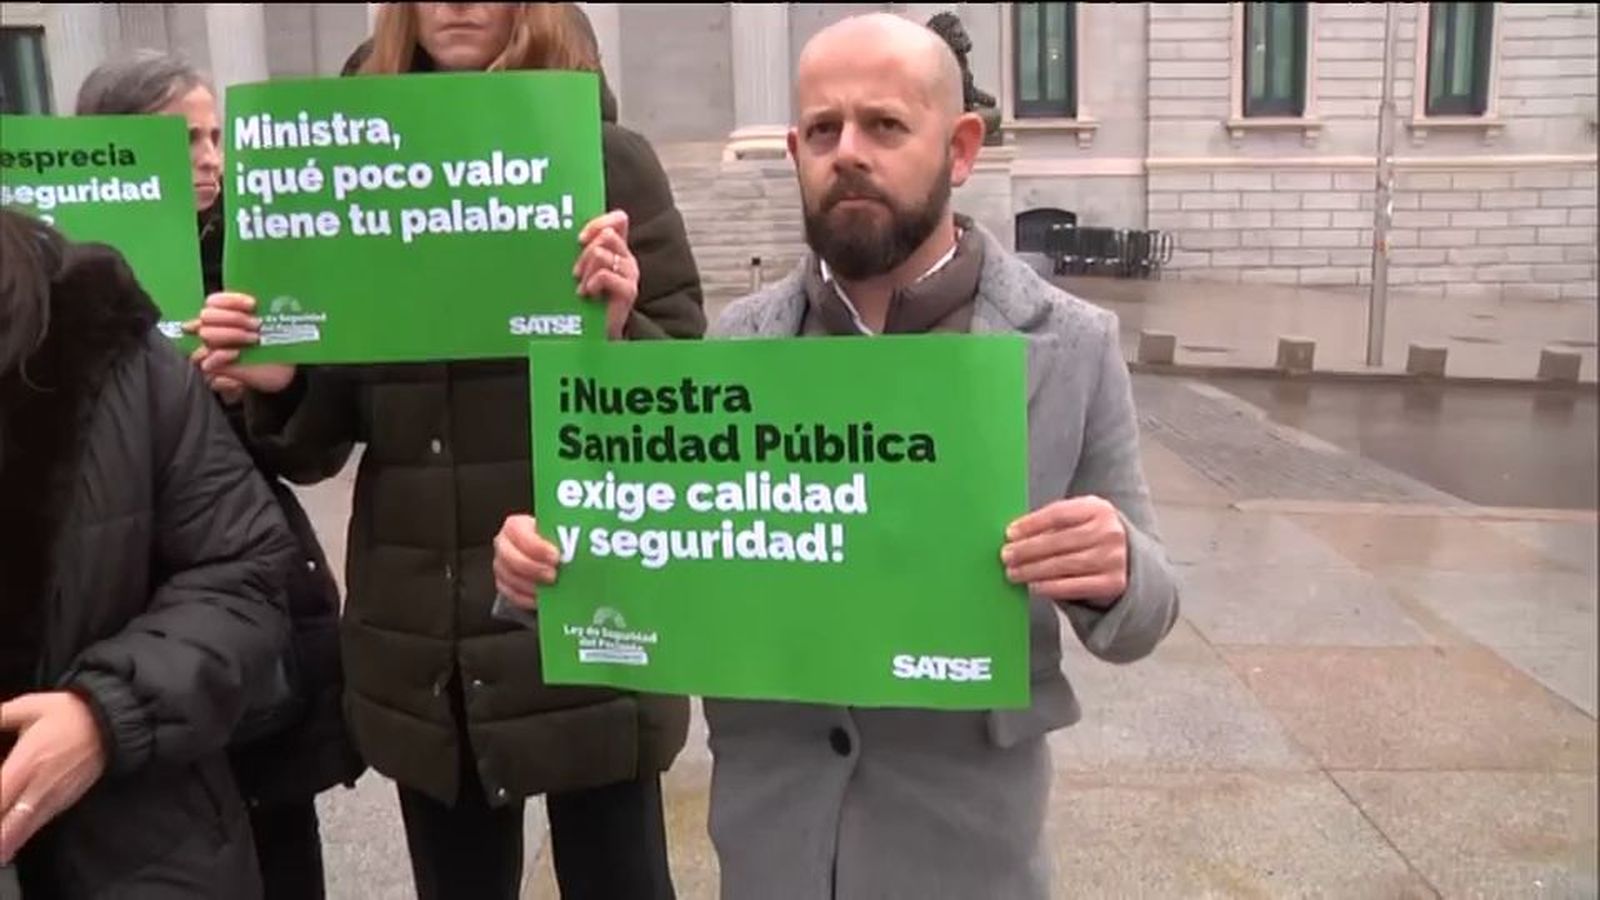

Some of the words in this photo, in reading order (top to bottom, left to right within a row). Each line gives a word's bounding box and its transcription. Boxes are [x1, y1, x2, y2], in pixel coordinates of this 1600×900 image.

[234, 111, 401, 151] Ministra,
[0, 175, 162, 209] seguridad
[236, 158, 325, 204] ¡qué
[332, 162, 433, 200] poco
[442, 150, 549, 187] valor
[236, 205, 341, 240] tiene
[348, 203, 392, 236] tu
[400, 194, 574, 243] palabra!
[508, 314, 583, 336] SATSE
[559, 376, 752, 415] ¡Nuestra
[558, 423, 741, 463] Sanidad
[755, 421, 936, 463] Pública
[556, 471, 676, 522] exige
[686, 471, 868, 514] calidad
[556, 524, 581, 563] y
[589, 519, 844, 568] seguridad!
[892, 654, 993, 682] SATSE
